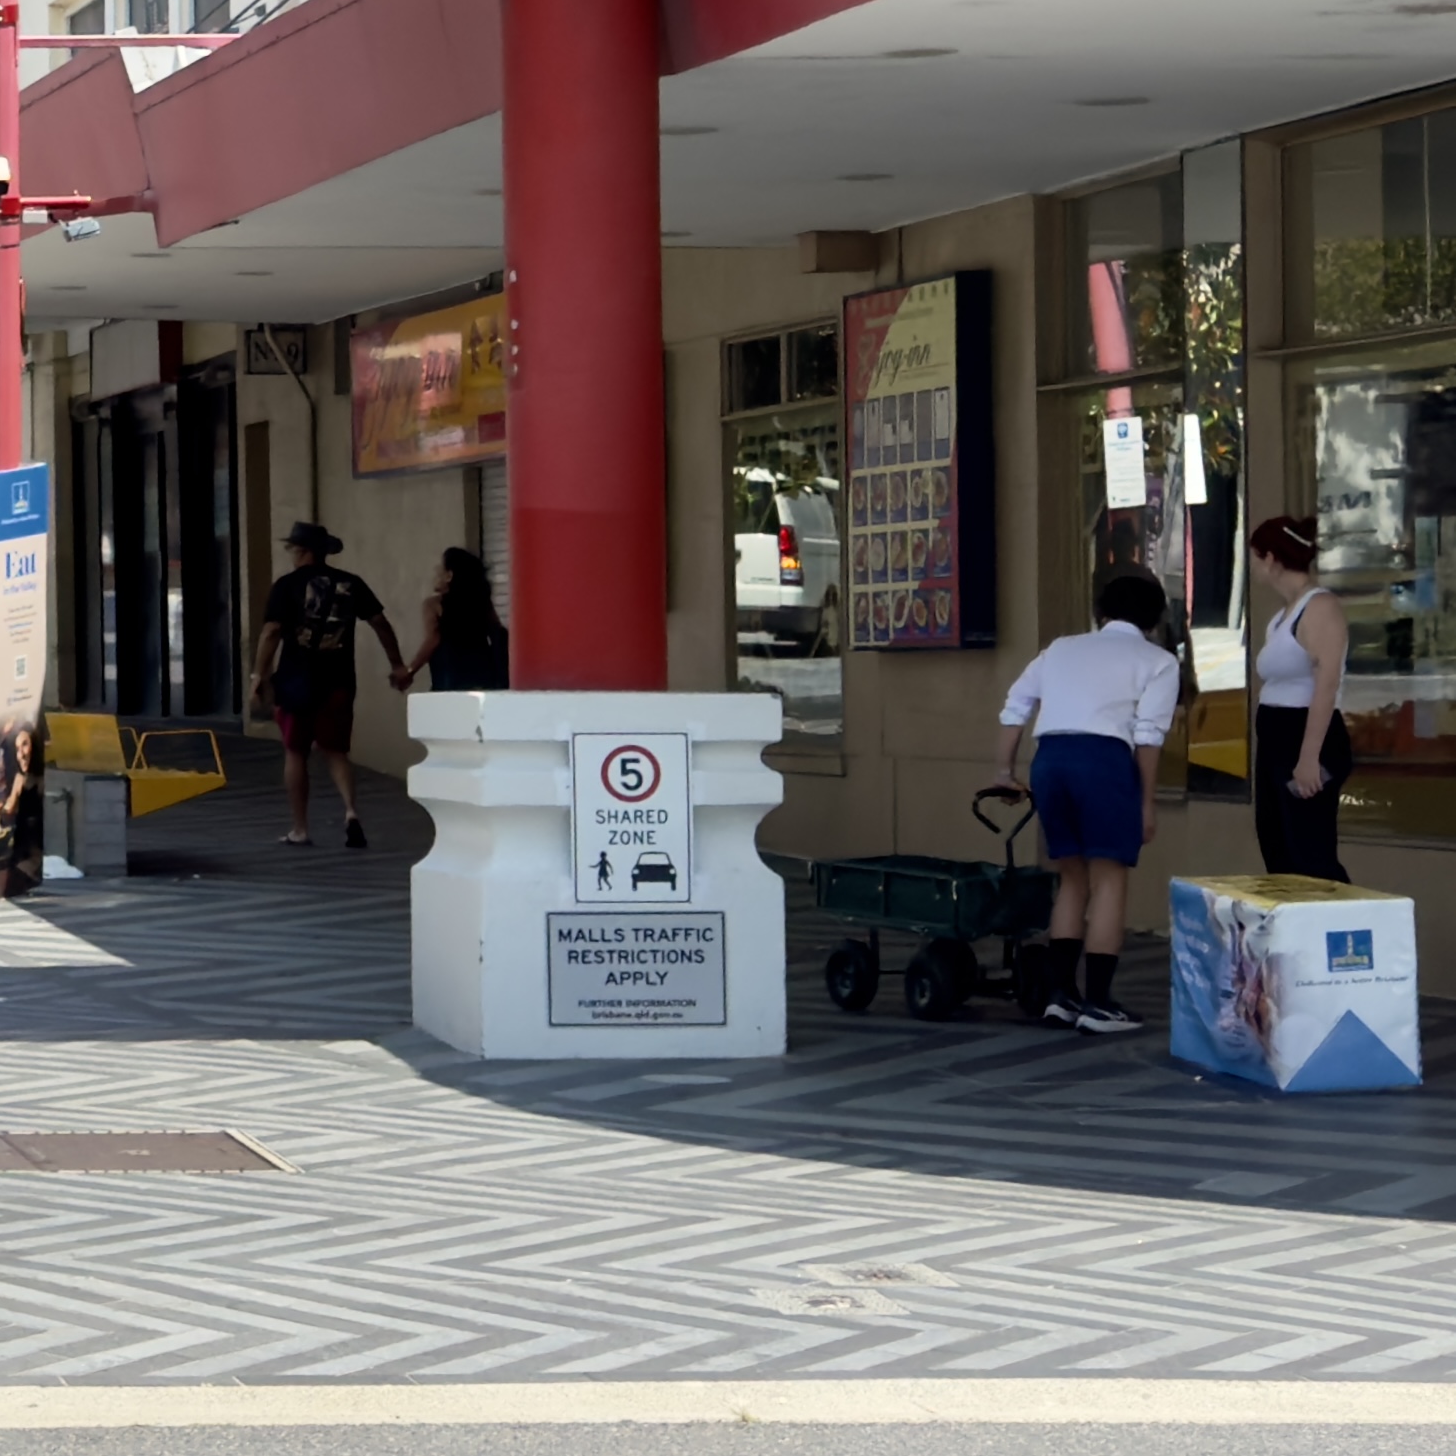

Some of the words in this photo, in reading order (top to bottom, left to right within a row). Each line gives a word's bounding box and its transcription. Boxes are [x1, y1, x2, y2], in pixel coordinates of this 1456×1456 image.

[5, 549, 38, 580] Eat
[620, 758, 643, 791] 5
[595, 809, 668, 825] SHARED
[609, 830, 657, 846] ZONE
[558, 928, 625, 943] MALLS
[631, 927, 714, 943] TRAFFIC
[567, 949, 705, 965] RESTRICTIONS
[605, 971, 669, 986] APPLY
[578, 999, 623, 1008] FURTHER
[625, 998, 697, 1008] INFORMATION
